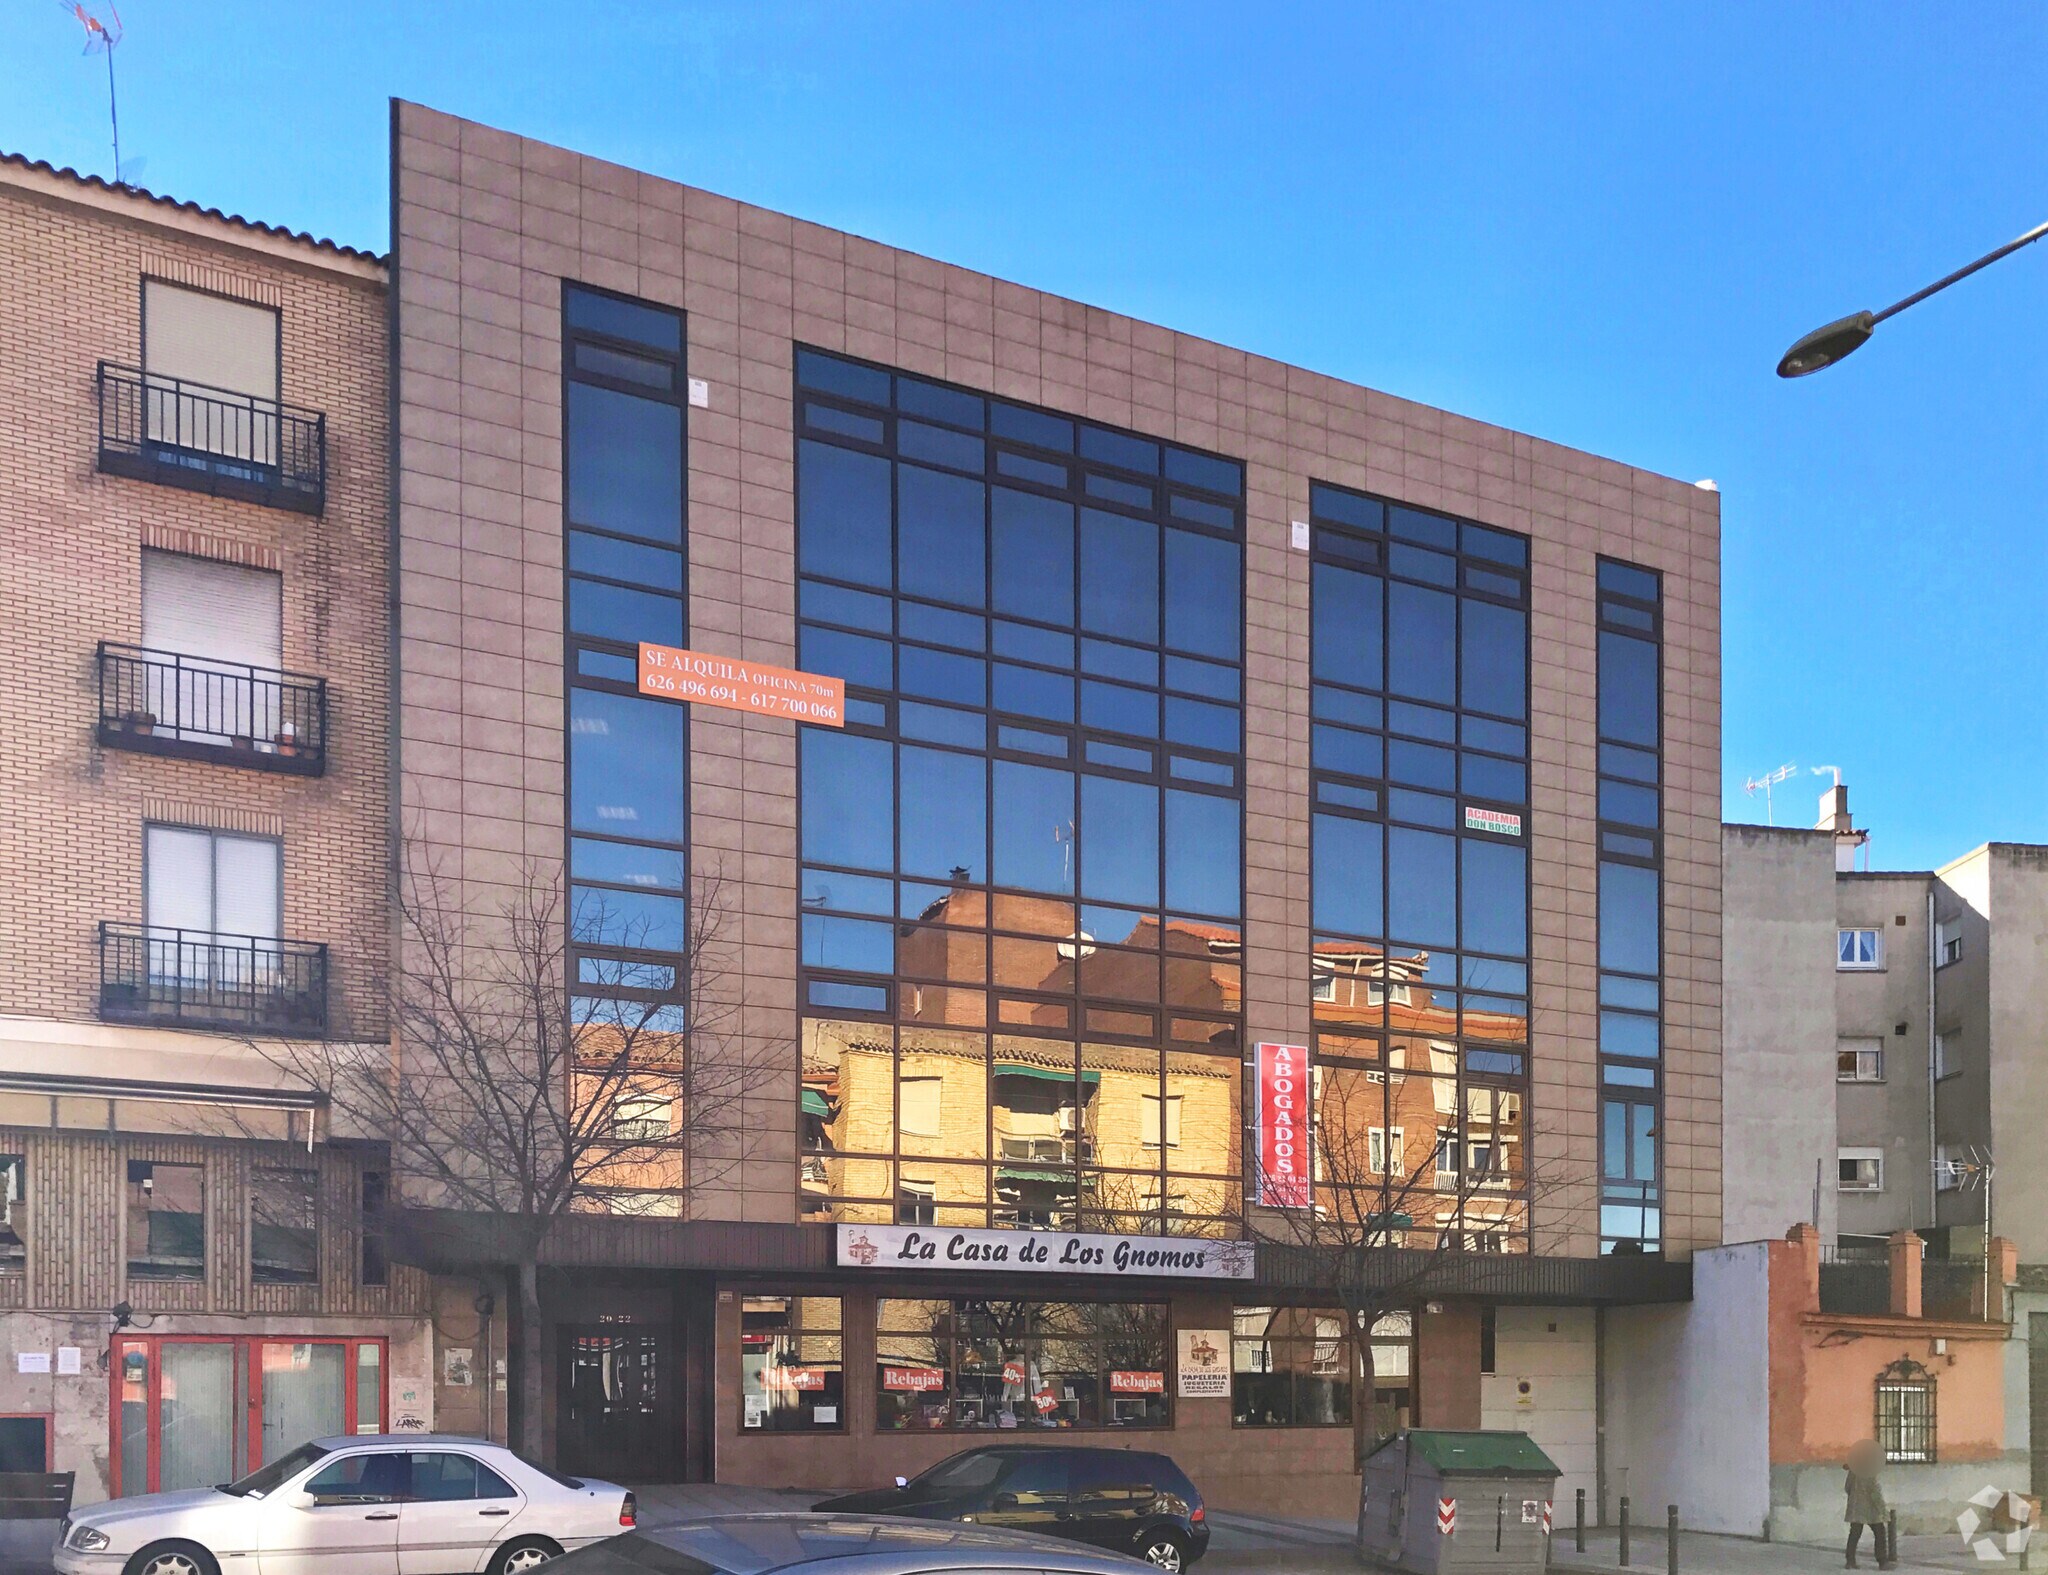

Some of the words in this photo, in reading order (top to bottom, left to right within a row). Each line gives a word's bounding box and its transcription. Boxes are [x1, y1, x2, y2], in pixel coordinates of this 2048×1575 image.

[646, 650, 667, 668] SE
[671, 655, 749, 683] ALQUILA
[752, 673, 807, 694] OFICINA
[646, 674, 675, 691] 626
[679, 680, 707, 696] 496
[710, 685, 737, 702] 694
[750, 692, 777, 710] 617
[781, 698, 808, 714] 700
[811, 703, 837, 719] 066
[1467, 808, 1519, 825] ACADEMIA
[1467, 818, 1486, 829] DON
[1488, 822, 1519, 835] BOSCO
[1273, 1047, 1294, 1173] ABOGADOS
[897, 1232, 937, 1260] La
[946, 1234, 1008, 1262] Casa
[1018, 1237, 1048, 1264] de
[1059, 1238, 1104, 1266] Los
[1112, 1241, 1205, 1272] Gnomos
[885, 1370, 944, 1389] Rebajas
[1112, 1374, 1163, 1391] Rebajas
